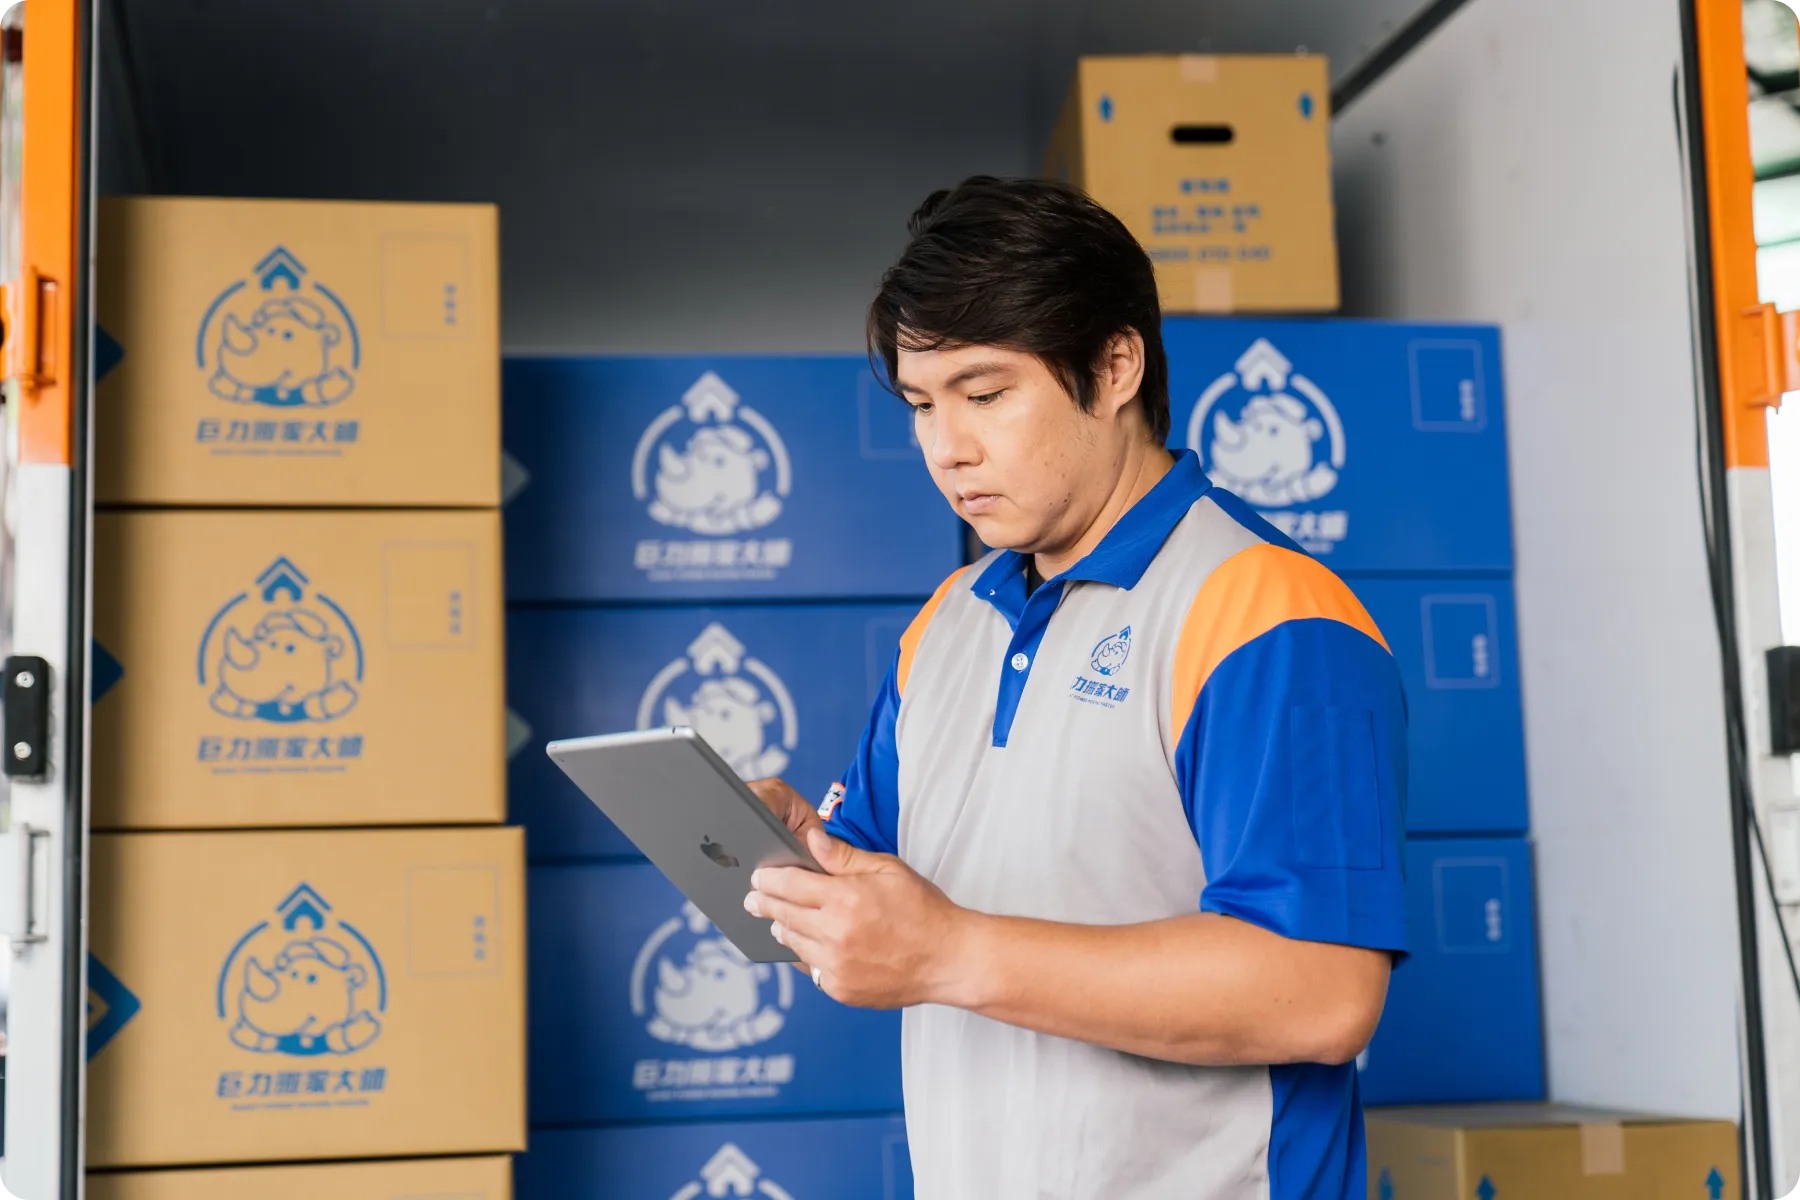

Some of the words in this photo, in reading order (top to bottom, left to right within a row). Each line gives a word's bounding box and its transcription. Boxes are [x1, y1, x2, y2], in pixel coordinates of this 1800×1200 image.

[1070, 676, 1130, 702] 力搬家大師
